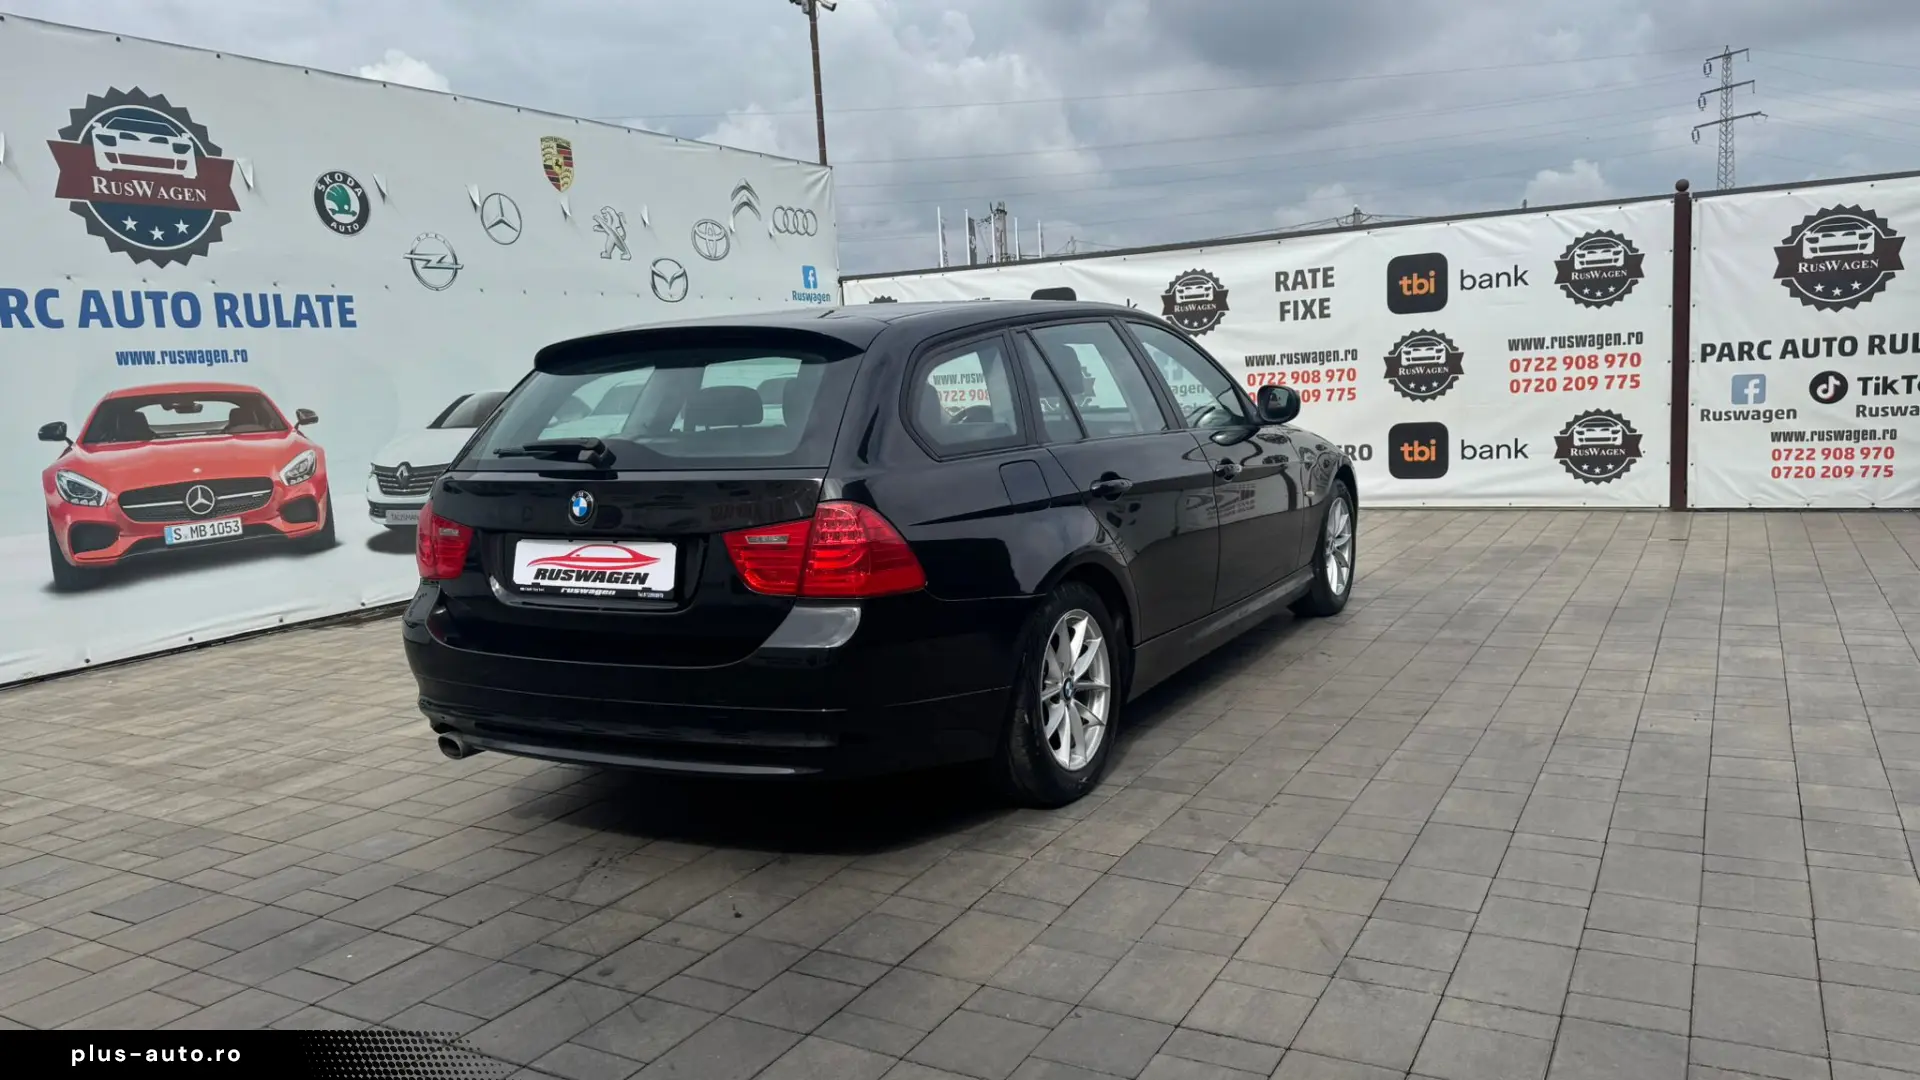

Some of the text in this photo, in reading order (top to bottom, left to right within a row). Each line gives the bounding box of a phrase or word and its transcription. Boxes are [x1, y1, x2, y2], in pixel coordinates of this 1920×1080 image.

[330, 221, 360, 233] AUTO
[1274, 266, 1336, 293] RATE
[1399, 264, 1530, 296] tbi bank
[791, 290, 832, 305] Ruswagen
[78, 289, 202, 329] AUTO
[213, 292, 358, 329] RULATE
[1279, 297, 1332, 322] FIXE
[1507, 330, 1644, 352] www.ruswagen.ro
[1699, 339, 1773, 363] PARC
[1778, 334, 1859, 360] AUTO
[115, 348, 249, 367] www.ruswagen.ro
[1244, 348, 1359, 368] www.ruswagen.ro
[1509, 352, 1643, 374] 0722 908 970
[1246, 367, 1357, 387] 0722 908 970
[1509, 373, 1641, 394] 0720 209 775
[1856, 374, 1920, 397] TikT
[1300, 386, 1357, 404] 09 775
[1699, 407, 1798, 423] Ruswagen
[1770, 428, 1898, 444] www.ruswagen.ro
[1400, 437, 1530, 462] tbi bank
[1771, 445, 1895, 462] 0722 908 970
[1770, 464, 1894, 479] 0720 209 775
[209, 519, 240, 536] 1053
[533, 567, 650, 585] RUSWAGEN
[560, 587, 616, 596] ruswagen
